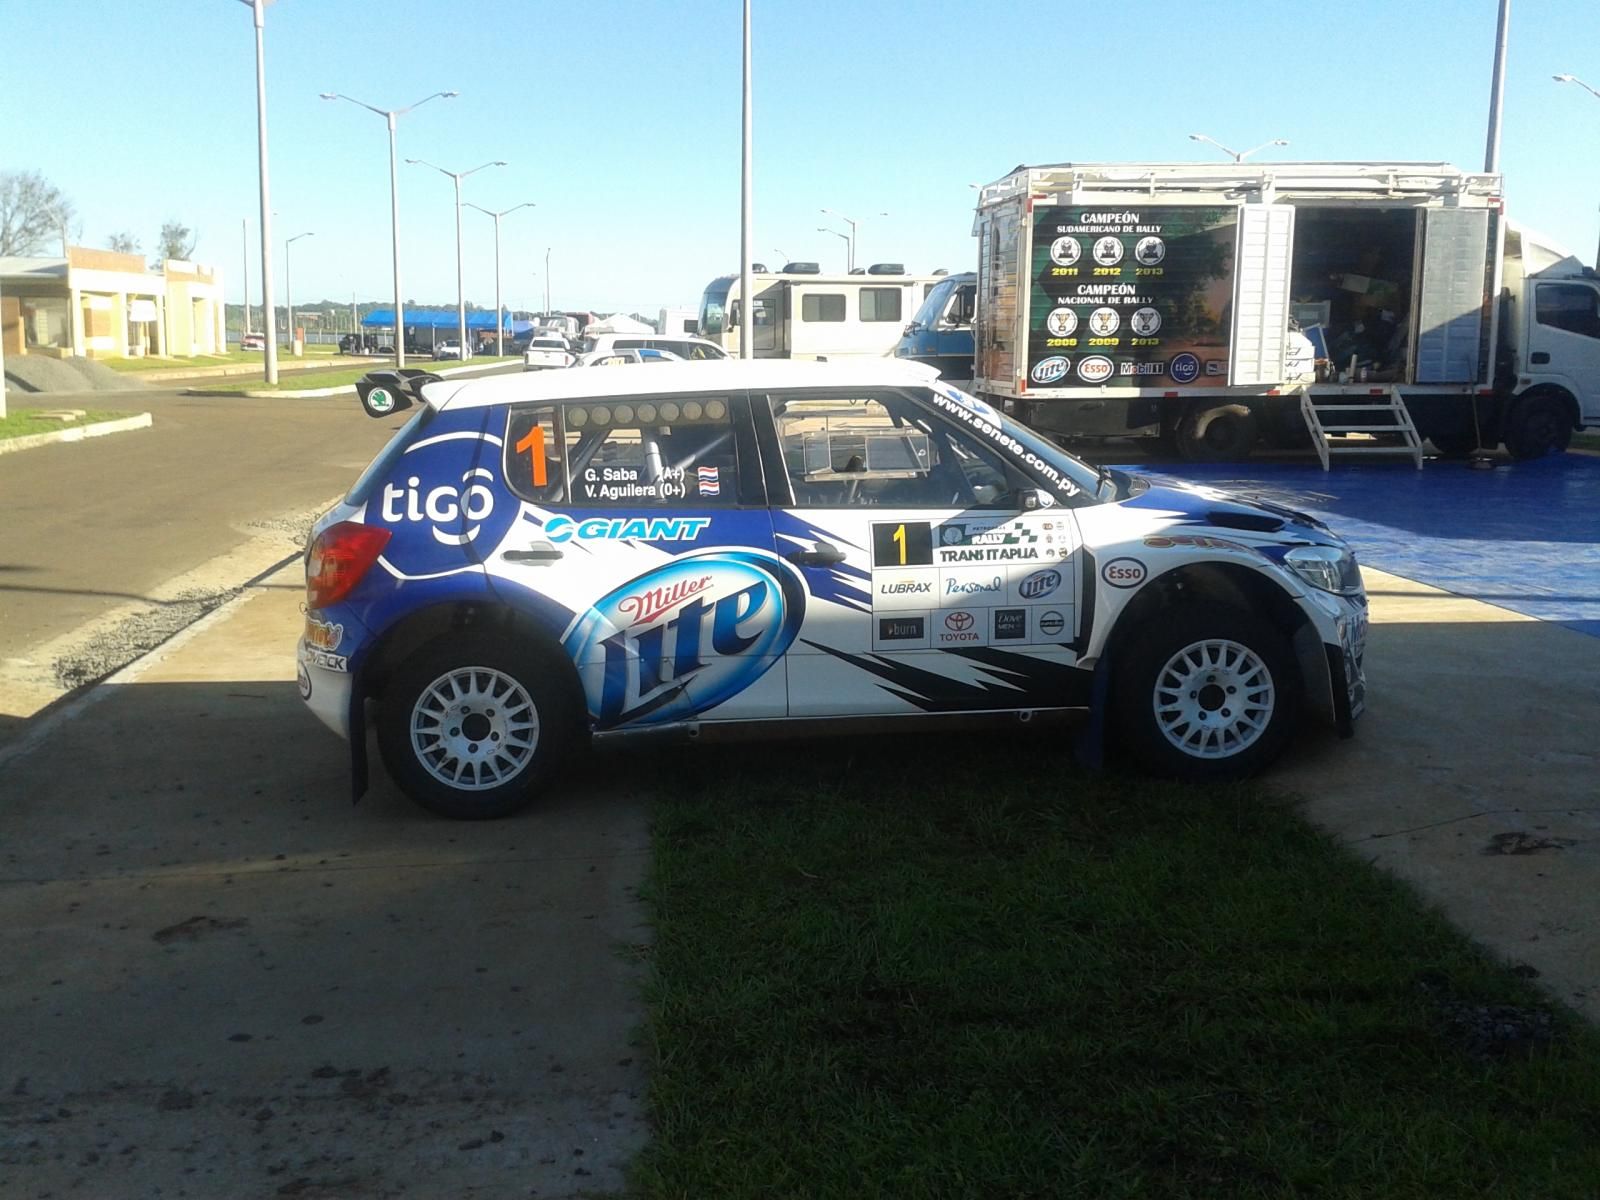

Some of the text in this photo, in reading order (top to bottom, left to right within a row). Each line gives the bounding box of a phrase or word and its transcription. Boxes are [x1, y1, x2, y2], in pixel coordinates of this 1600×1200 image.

[1081, 211, 1139, 224] CAMPEÓN
[1122, 225, 1134, 233] DE
[1136, 225, 1162, 233] RALLY
[1052, 268, 1164, 276] 2011 2012 2013
[1077, 282, 1136, 295] CAMPEÓN
[1108, 296, 1121, 304] DE
[1123, 296, 1153, 304] RALLY
[1130, 338, 1159, 346] 2013
[1120, 362, 1153, 375] Mobil
[933, 393, 1080, 497] www.senete.com.py
[516, 426, 547, 487] 1
[585, 466, 685, 482] G. Saba (A+)
[585, 485, 597, 497] V.
[600, 484, 656, 499] Aguilera
[577, 518, 711, 540] GIANT
[893, 524, 907, 565] 1
[972, 533, 1005, 545] RALLY
[881, 583, 932, 594] LUBRAX
[946, 576, 1001, 596] Personal
[618, 576, 713, 626] Miller
[893, 623, 917, 635] burn
[940, 632, 980, 642] TOYOTA
